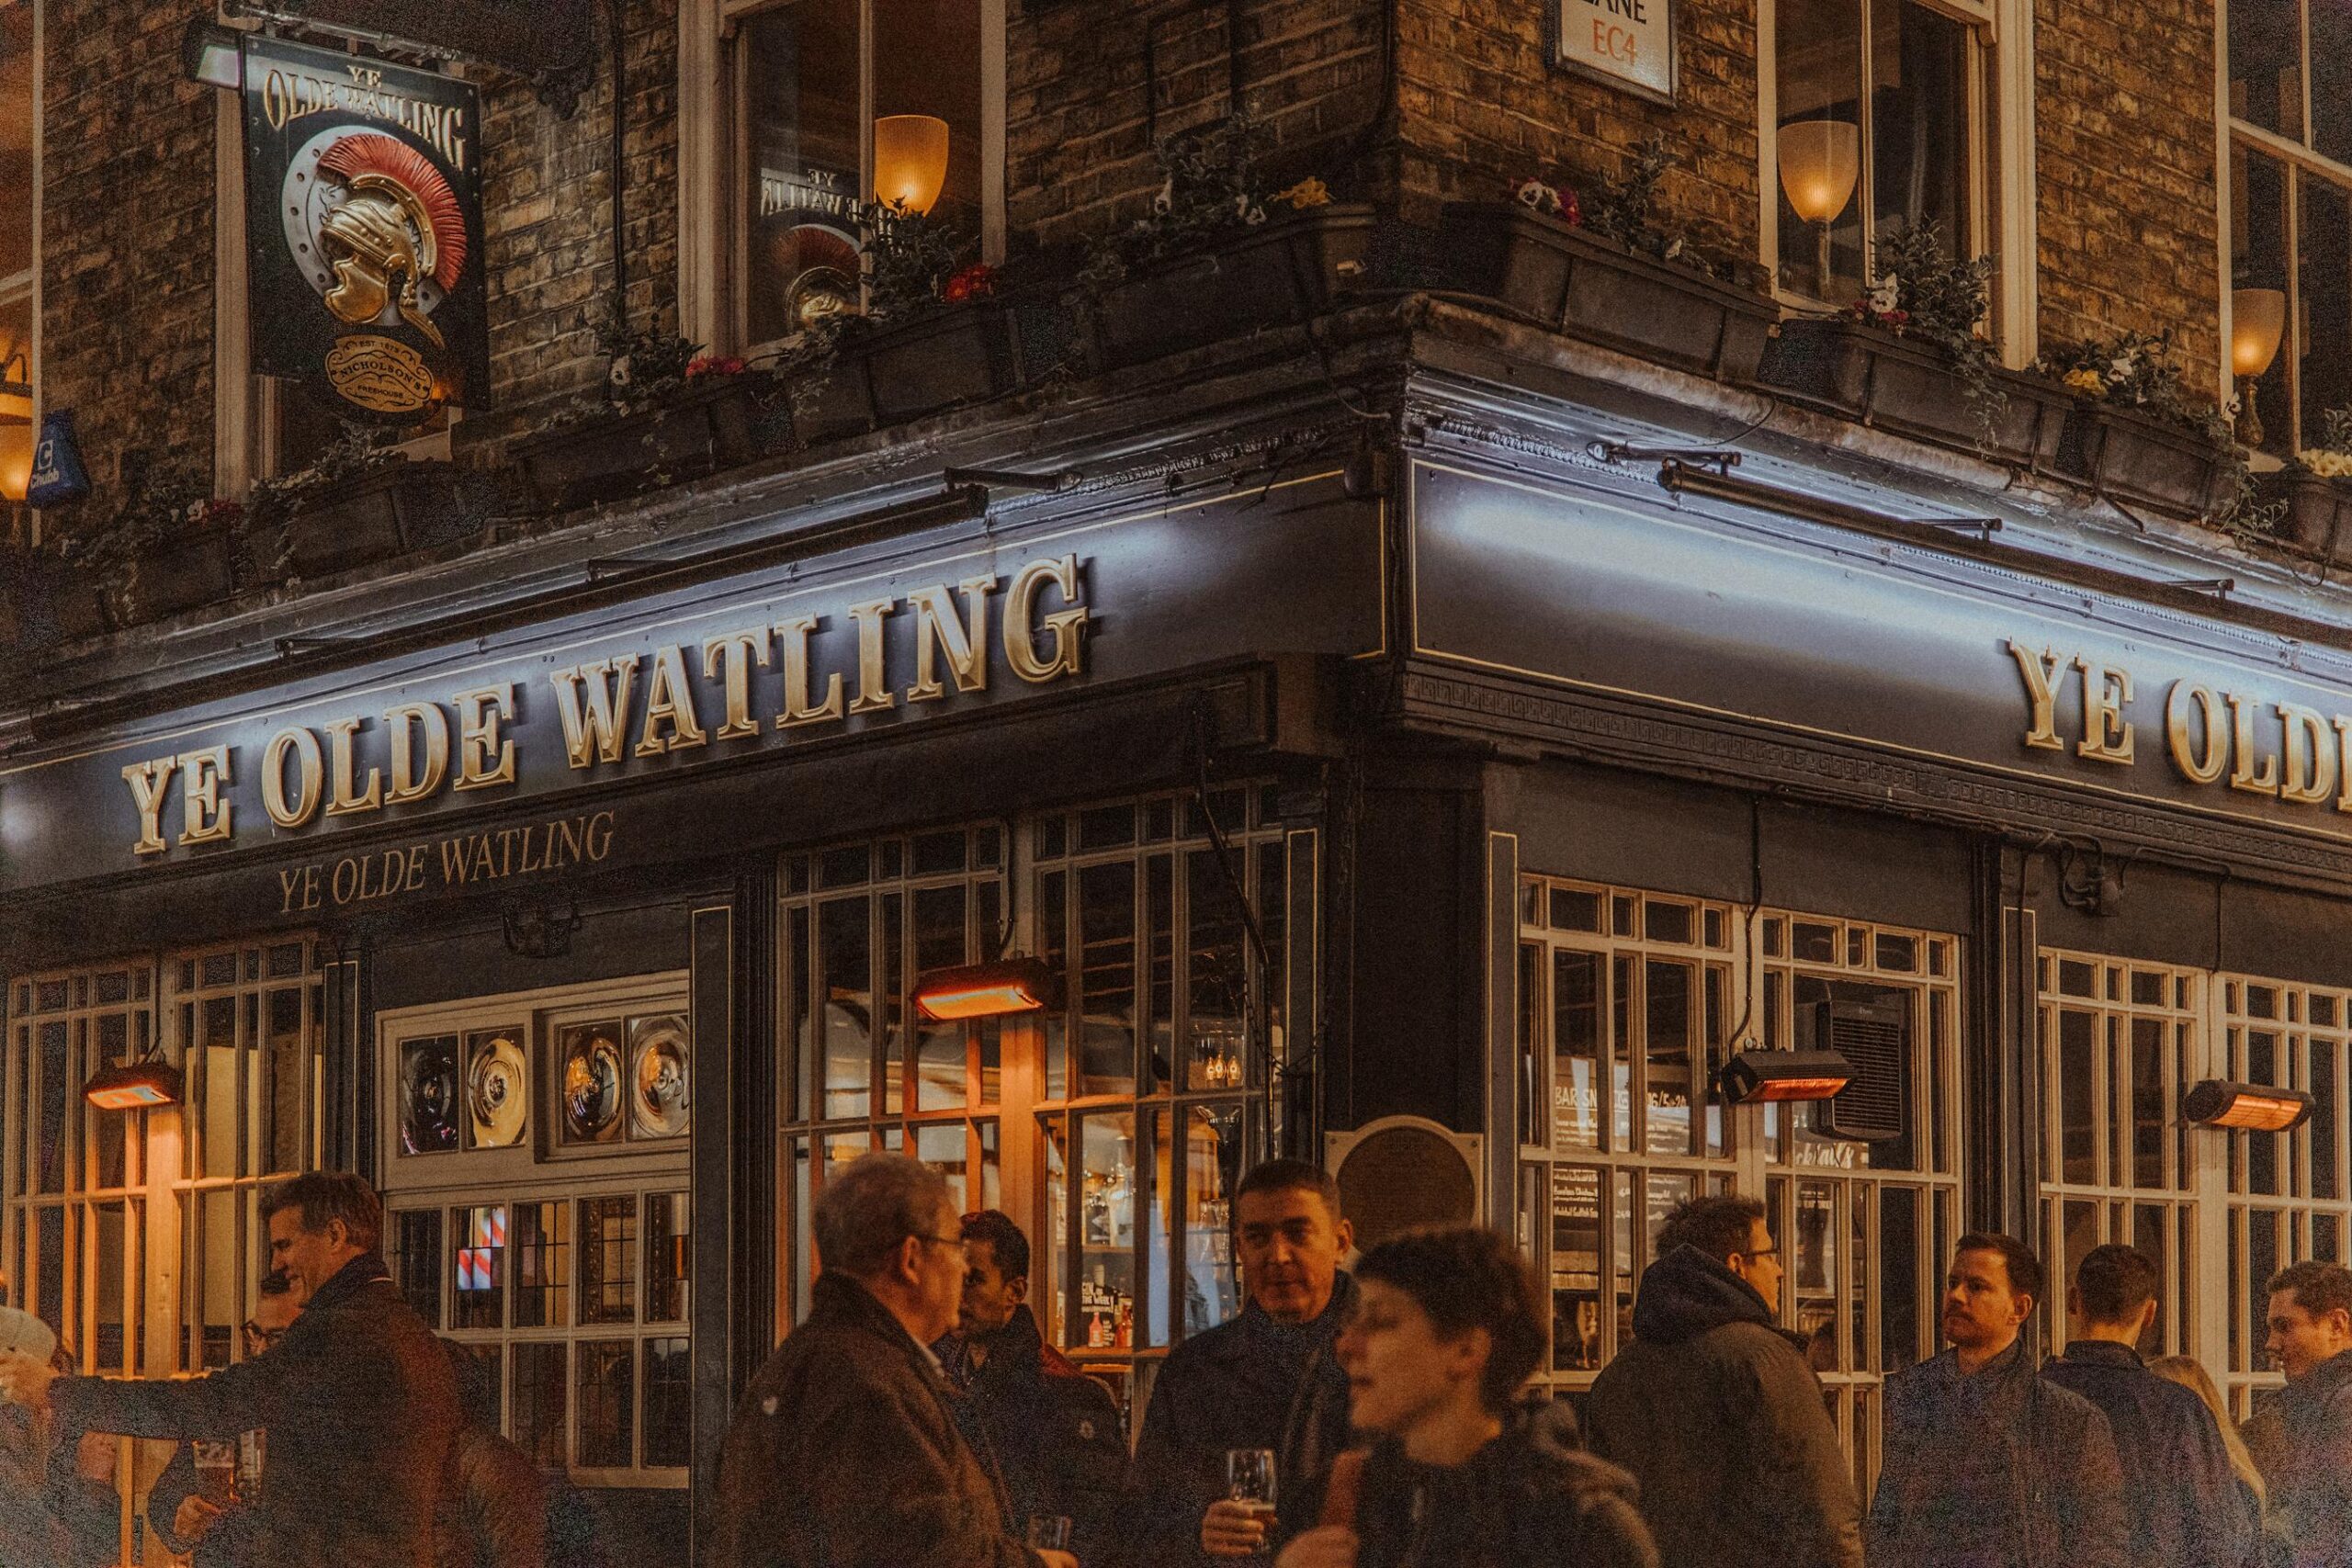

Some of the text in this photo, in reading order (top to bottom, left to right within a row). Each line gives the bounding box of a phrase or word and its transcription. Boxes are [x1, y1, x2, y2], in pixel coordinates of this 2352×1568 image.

[1581, 0, 1647, 25] NE
[1592, 18, 1636, 66] EC4
[346, 64, 382, 88] YE
[264, 69, 467, 172] OLDE WATLING
[359, 340, 376, 348] EST
[339, 360, 422, 391] NICHOLSON'S
[356, 385, 404, 399] FREEHOUSE
[31, 467, 59, 490] Chubb
[120, 552, 1089, 855] YE OLDE WATLING
[2007, 635, 2135, 766] YE
[279, 810, 615, 914] YE OLDE WATLING
[1555, 1087, 1577, 1107] BAR
